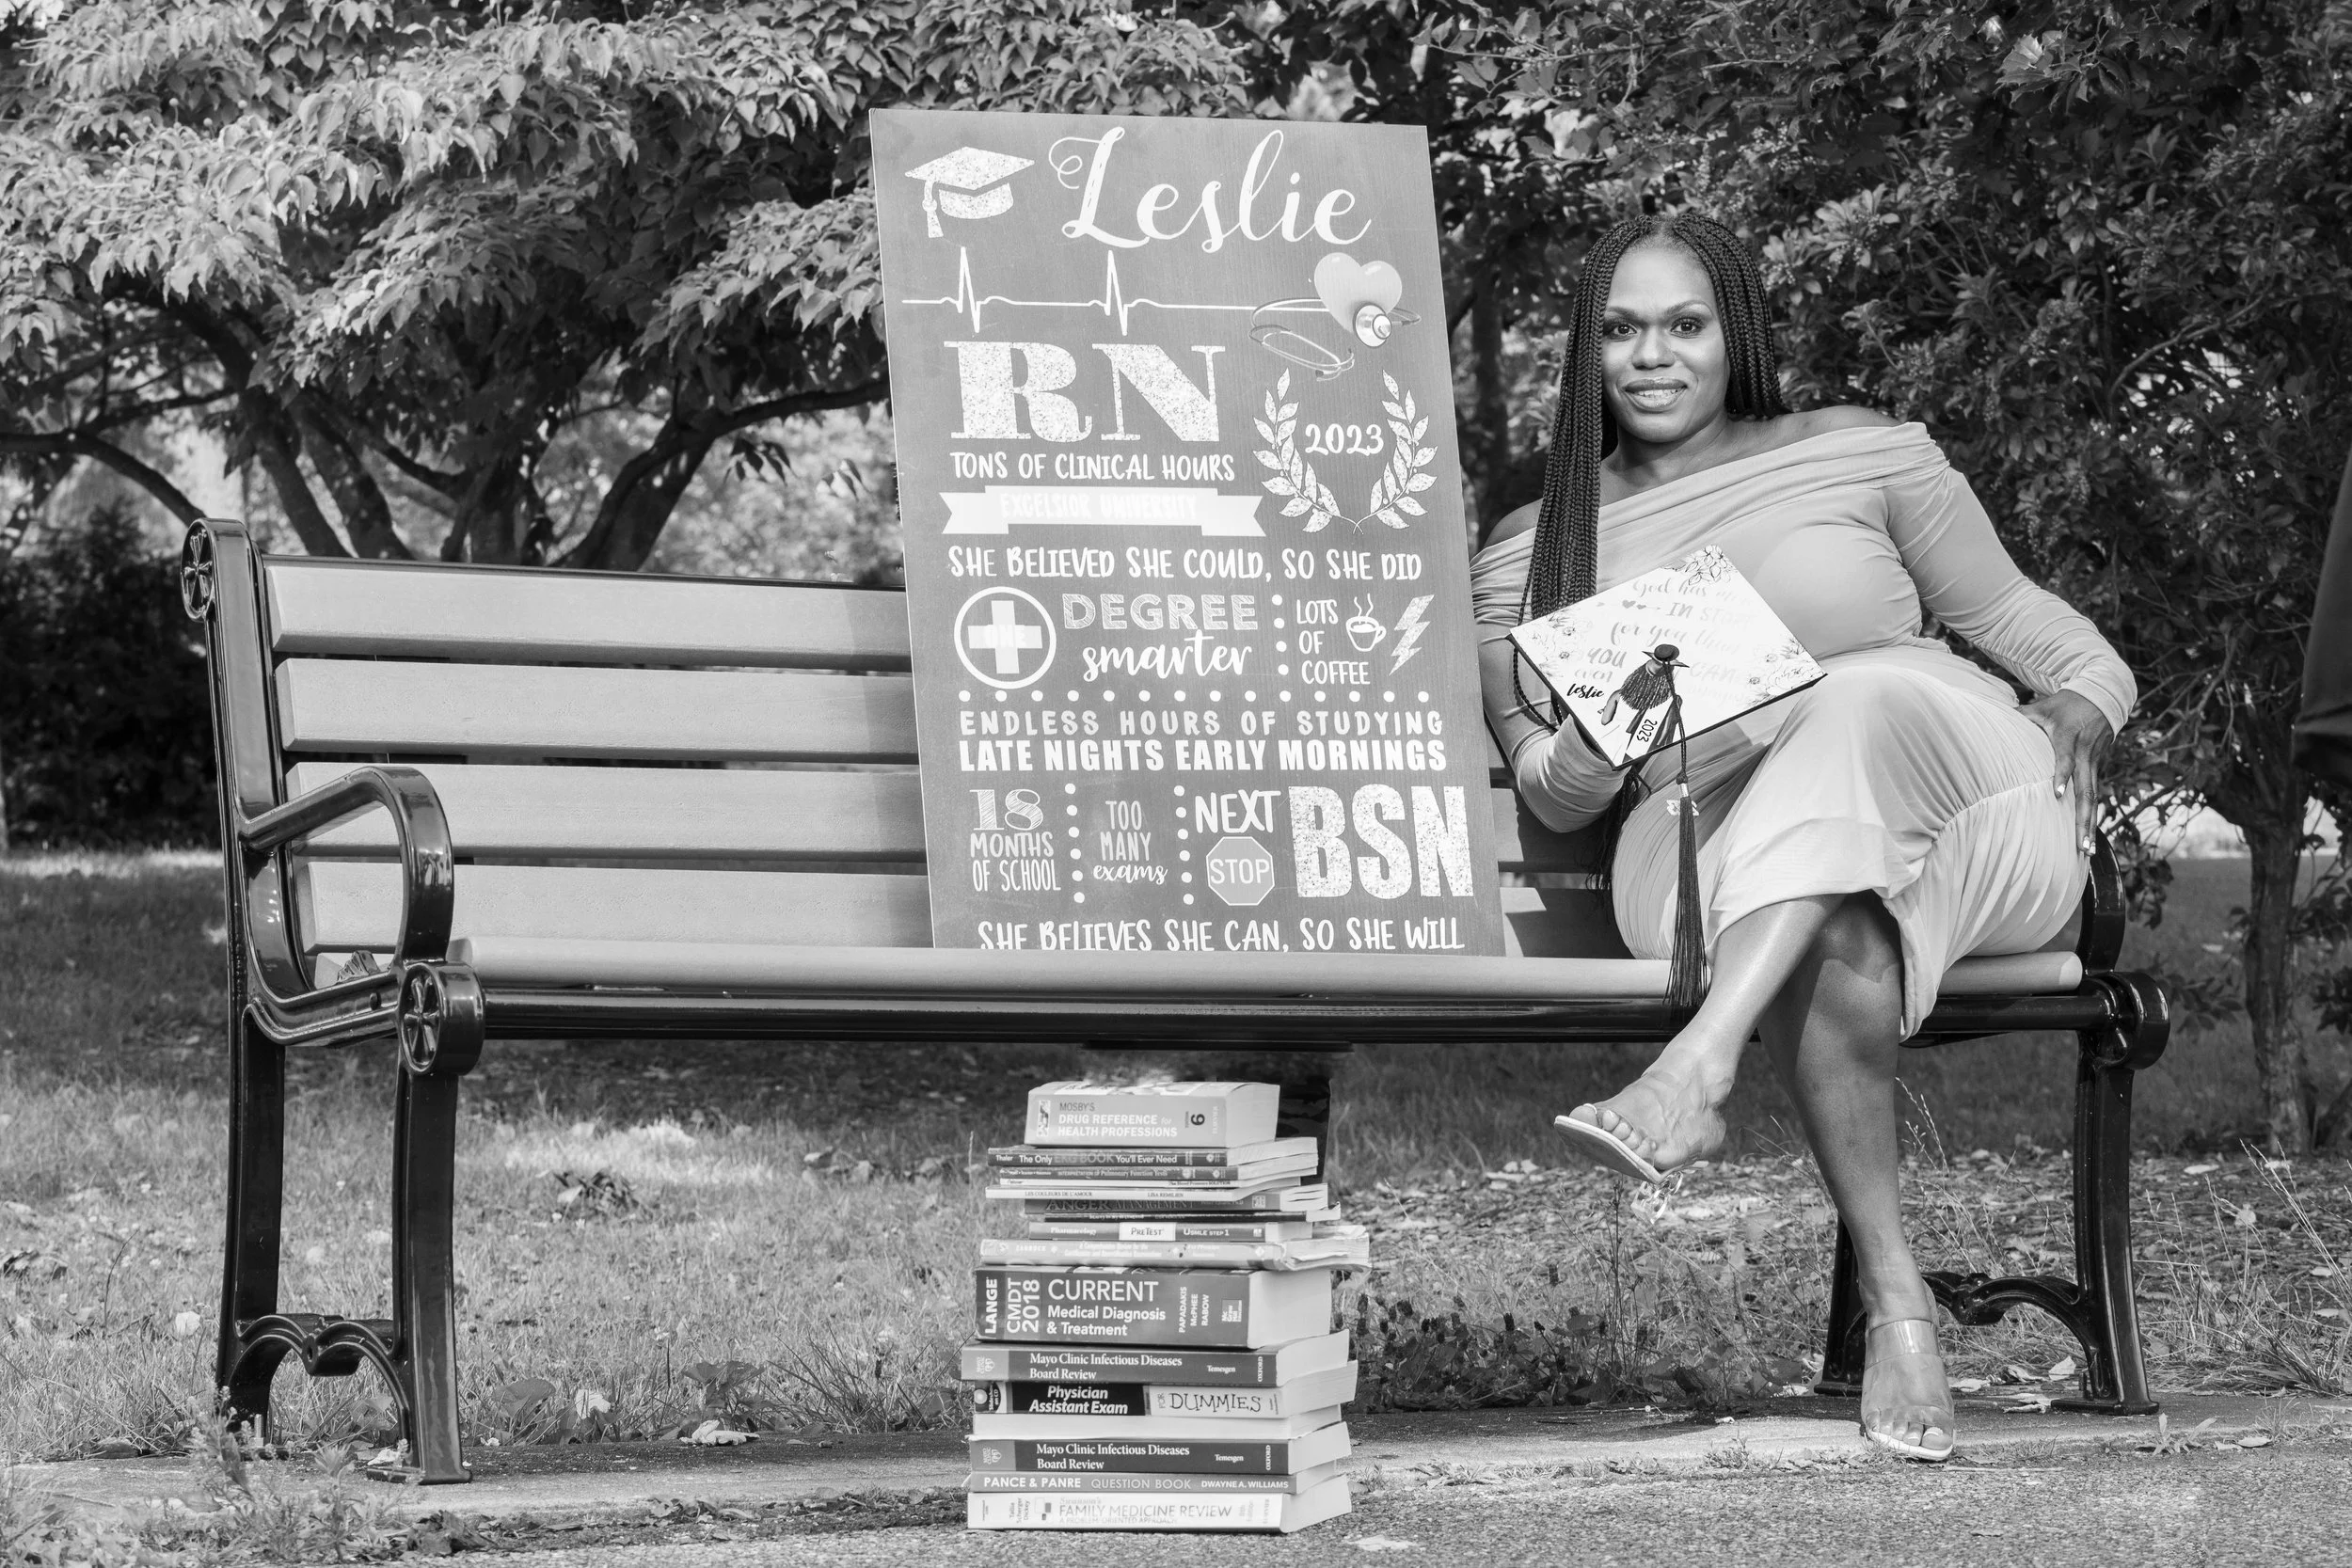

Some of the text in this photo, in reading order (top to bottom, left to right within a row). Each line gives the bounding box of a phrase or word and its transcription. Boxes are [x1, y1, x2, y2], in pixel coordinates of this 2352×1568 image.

[1048, 126, 1372, 253] Leslie
[944, 341, 1225, 442] RN
[1304, 423, 1384, 455] 2023
[951, 451, 1234, 482] TONS OF CLINICAL HOURS
[1000, 492, 1197, 520] EXCELSIOR UNIVERSITY
[948, 546, 1422, 582] SHE BELIEVED SHE COULD, SO SHE DID
[1062, 593, 1259, 630] DEGREE
[1295, 598, 1337, 625] LOTS
[1083, 629, 1251, 681] smarter
[1298, 630, 1325, 655] OF
[1301, 660, 1370, 685] COFFEE
[960, 710, 1443, 736] ENDLESS HOURS OF STUDYING
[1637, 719, 1658, 742] 2023
[960, 739, 1447, 771] LATE NIGHTS EARLY MORNINGS
[969, 788, 1044, 832] 18
[1106, 800, 1142, 832] TOO
[1195, 790, 1281, 833] NEXT
[970, 832, 1054, 859] MONTHS
[1101, 832, 1152, 862] MANY
[1288, 784, 1473, 899] BSN
[973, 859, 1061, 892] OF SCHOOL
[1093, 863, 1168, 886] exams
[1210, 858, 1269, 883] STOP
[977, 917, 1465, 954] SHE BELIEVES SHE CAN, SO SHE WILL
[1059, 1101, 1095, 1112] MOSBY'S
[1057, 1125, 1178, 1137] HEALTH PROFESSIONS
[1058, 1114, 1089, 1125] DRUG
[1092, 1115, 1157, 1125] REFERENCE
[1161, 1117, 1172, 1125] for
[1190, 1113, 1205, 1126] 6
[1020, 1154, 1034, 1164] The
[1035, 1154, 1053, 1165] Only
[1080, 1153, 1114, 1164] BOOK
[1115, 1154, 1136, 1164] You'll
[1137, 1154, 1154, 1164] Ever
[1156, 1154, 1177, 1164] Need
[1045, 1198, 1112, 1211] ANGER
[1114, 1199, 1193, 1210] MANAGEMENT
[1048, 1279, 1158, 1301] CURRENT
[985, 1278, 997, 1333] LANGE
[1007, 1277, 1022, 1333] CMDT
[1023, 1279, 1041, 1333] 2018
[1048, 1306, 1166, 1323] Medical Diagnosis
[1178, 1286, 1187, 1333] PAPADAKIS
[1190, 1293, 1199, 1327] McPHEE
[1201, 1293, 1210, 1327] RABOW
[1047, 1323, 1127, 1336] & Treatment
[1030, 1353, 1182, 1367] Mayo Clinic Infectious Diseases
[1207, 1365, 1235, 1375] Temesgen
[1029, 1368, 1097, 1380] Board Review
[1047, 1386, 1108, 1402] Physician
[1169, 1392, 1261, 1412] DUMMIES
[1029, 1400, 1128, 1414] Assistant Exam
[1037, 1443, 1189, 1457] Mayo Clinic Infectious Diseases
[1215, 1453, 1244, 1464] Temesgen
[1037, 1459, 1104, 1470] Board Review
[984, 1477, 1025, 1488] PANCE
[1029, 1477, 1039, 1488] &
[1042, 1477, 1081, 1488] PANRE
[1091, 1478, 1151, 1491] QUESTION
[1155, 1479, 1191, 1490] BOOK
[1248, 1481, 1289, 1489] WILLIAMS
[1059, 1504, 1109, 1517] FAMILY
[1112, 1504, 1175, 1518] MEDICINE
[1179, 1505, 1232, 1517] REVIEW
